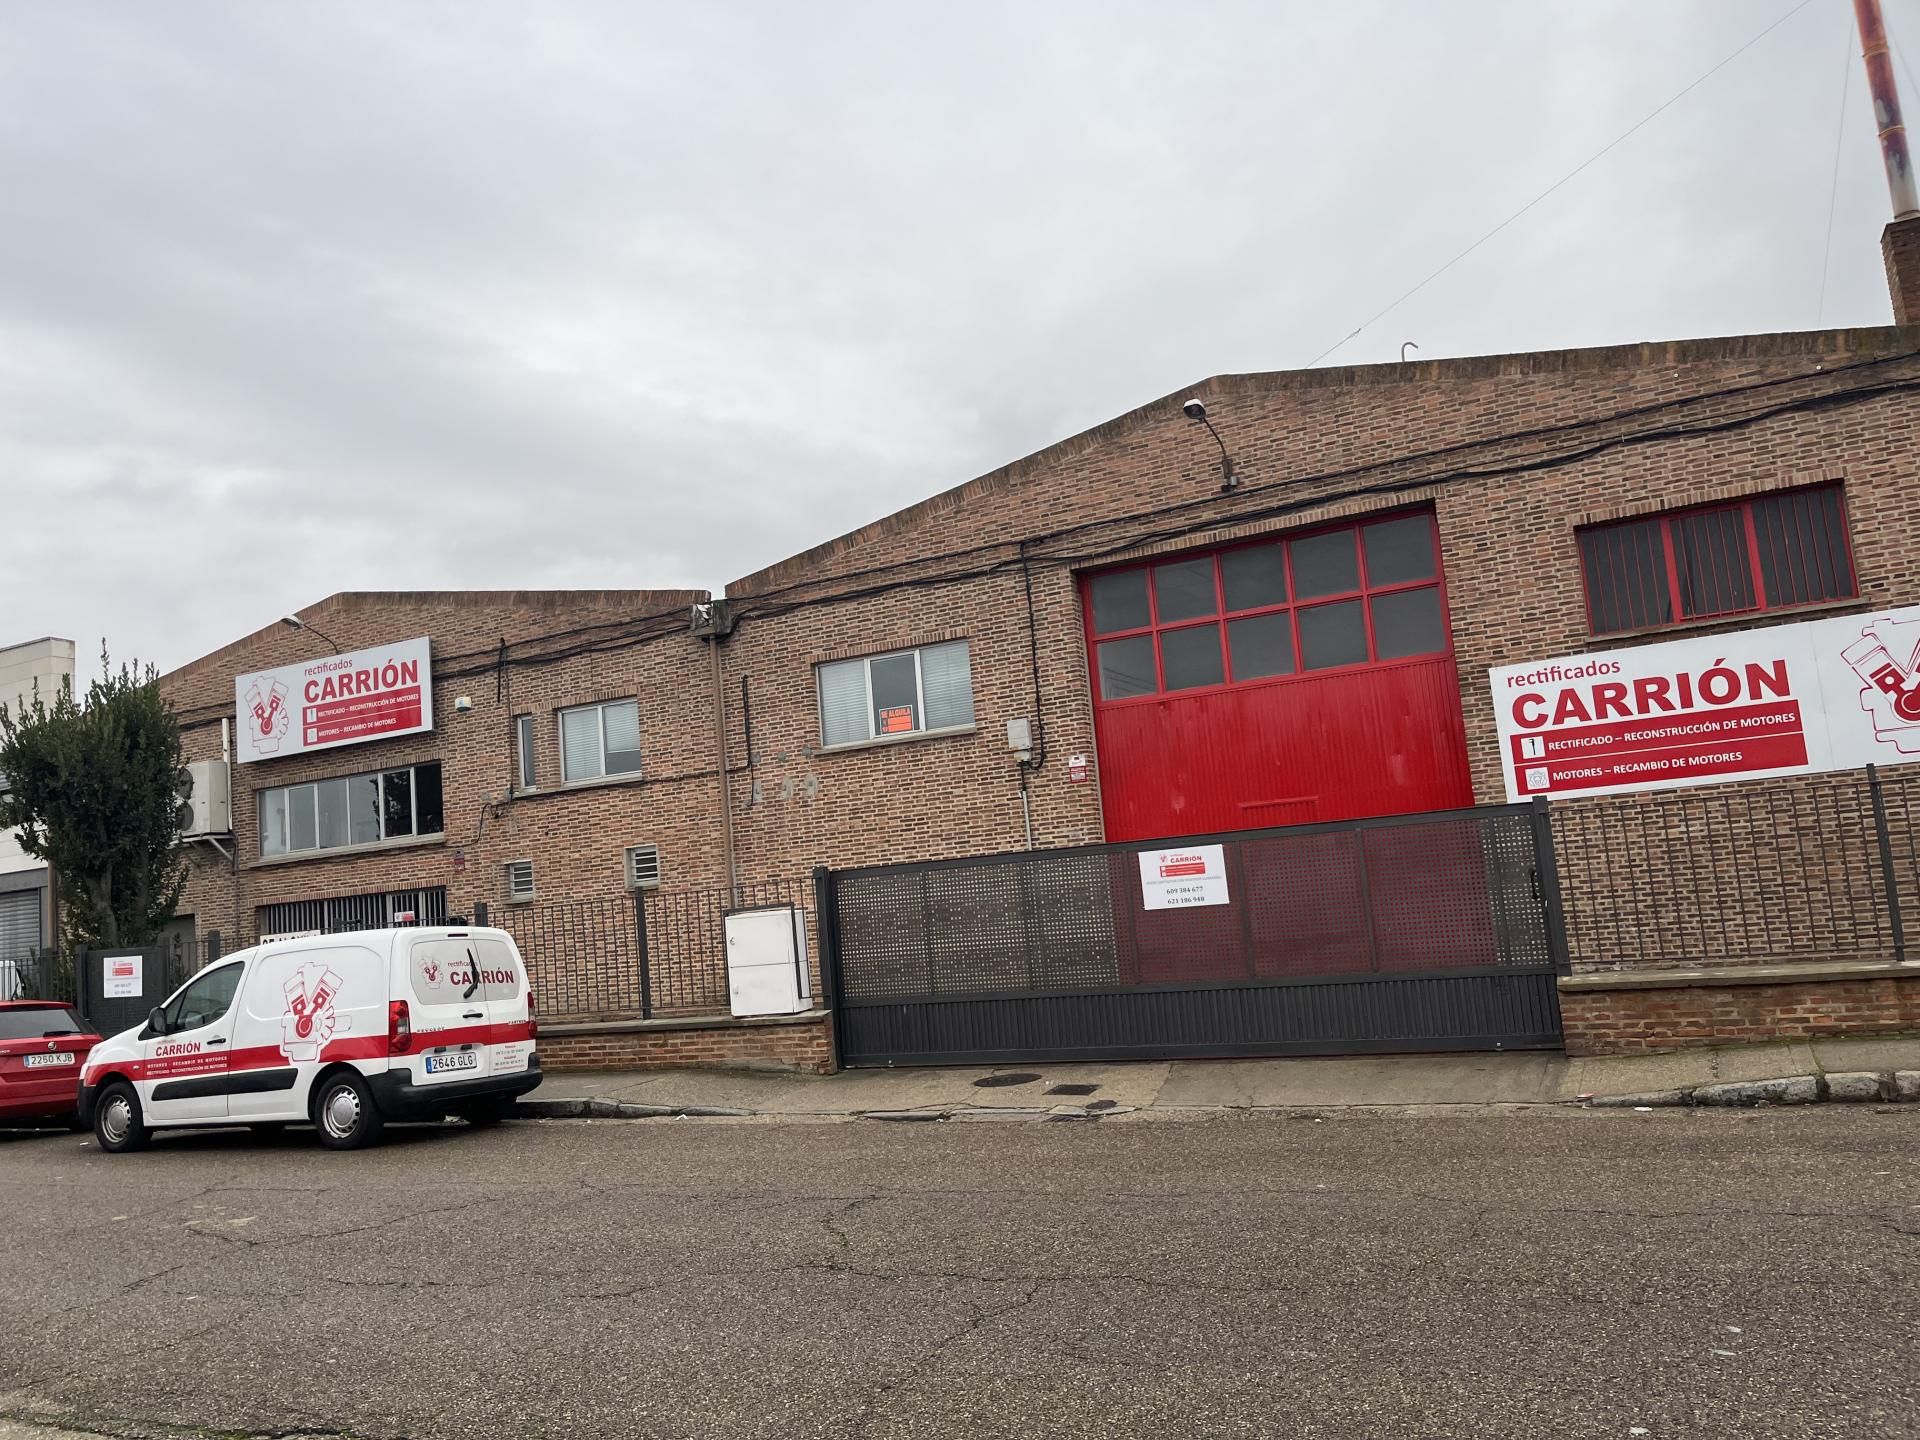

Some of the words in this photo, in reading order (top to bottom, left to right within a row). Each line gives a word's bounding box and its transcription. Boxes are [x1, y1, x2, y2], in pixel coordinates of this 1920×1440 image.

[304, 658, 353, 677] rectificados
[1506, 658, 1621, 688] rectificados
[304, 658, 418, 703] CARRIÓN
[389, 697, 397, 705] DE
[396, 693, 419, 704] MOTORES
[1511, 657, 1791, 729] CARRIÓN
[318, 727, 340, 738] MOTORES
[367, 720, 375, 729] DE
[374, 717, 397, 727] MOTORES
[1548, 734, 1613, 751] RECTIFICADO
[1624, 720, 1720, 743] RECONSTRUCCIÓN
[1723, 719, 1737, 731] DE
[1740, 712, 1796, 728] MOTORES
[1552, 766, 1603, 782] MOTORES
[1613, 760, 1669, 775] RECAMBIO
[1671, 758, 1686, 769] DE
[1688, 751, 1743, 766] MOTORES
[450, 966, 514, 985] CARIÓN
[155, 1040, 201, 1057] CARRIÓN
[433, 1056, 455, 1070] 2646
[457, 1055, 473, 1067] GLG
